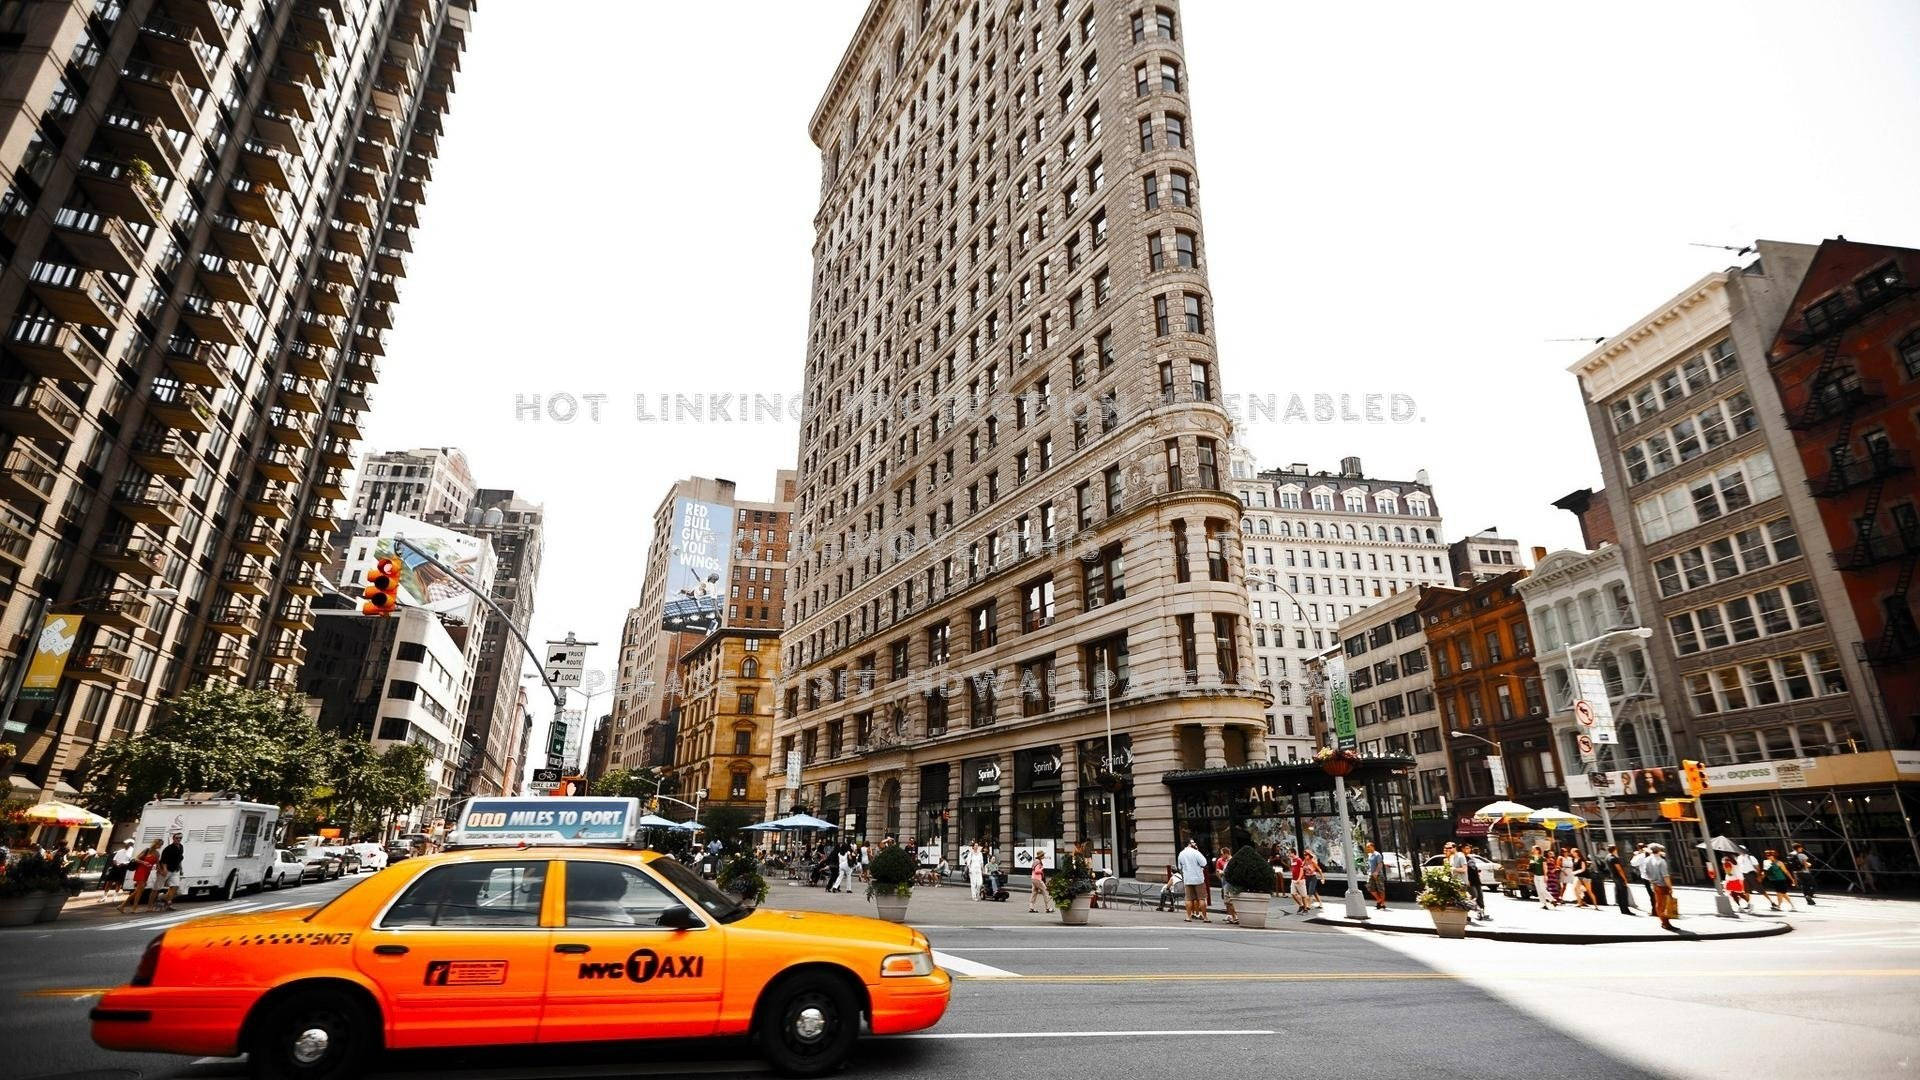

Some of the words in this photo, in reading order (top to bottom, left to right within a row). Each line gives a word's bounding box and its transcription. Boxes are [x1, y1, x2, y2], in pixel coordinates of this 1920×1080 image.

[685, 503, 708, 517] RED
[684, 515, 711, 531] BULL
[682, 540, 706, 555] YOU
[680, 552, 722, 572] WINGS.
[561, 673, 580, 681] LOCAL
[1033, 760, 1053, 774] Sprint
[1101, 753, 1124, 769] Spint
[978, 767, 995, 782] Sprint
[1727, 767, 1771, 780] express
[1249, 785, 1275, 802] Art
[1177, 801, 1230, 818] Flatiron
[508, 811, 554, 826] MILES
[558, 811, 574, 825] TO
[580, 811, 622, 826] PORT.
[578, 963, 624, 980] NYC
[627, 950, 704, 982] TAXI
